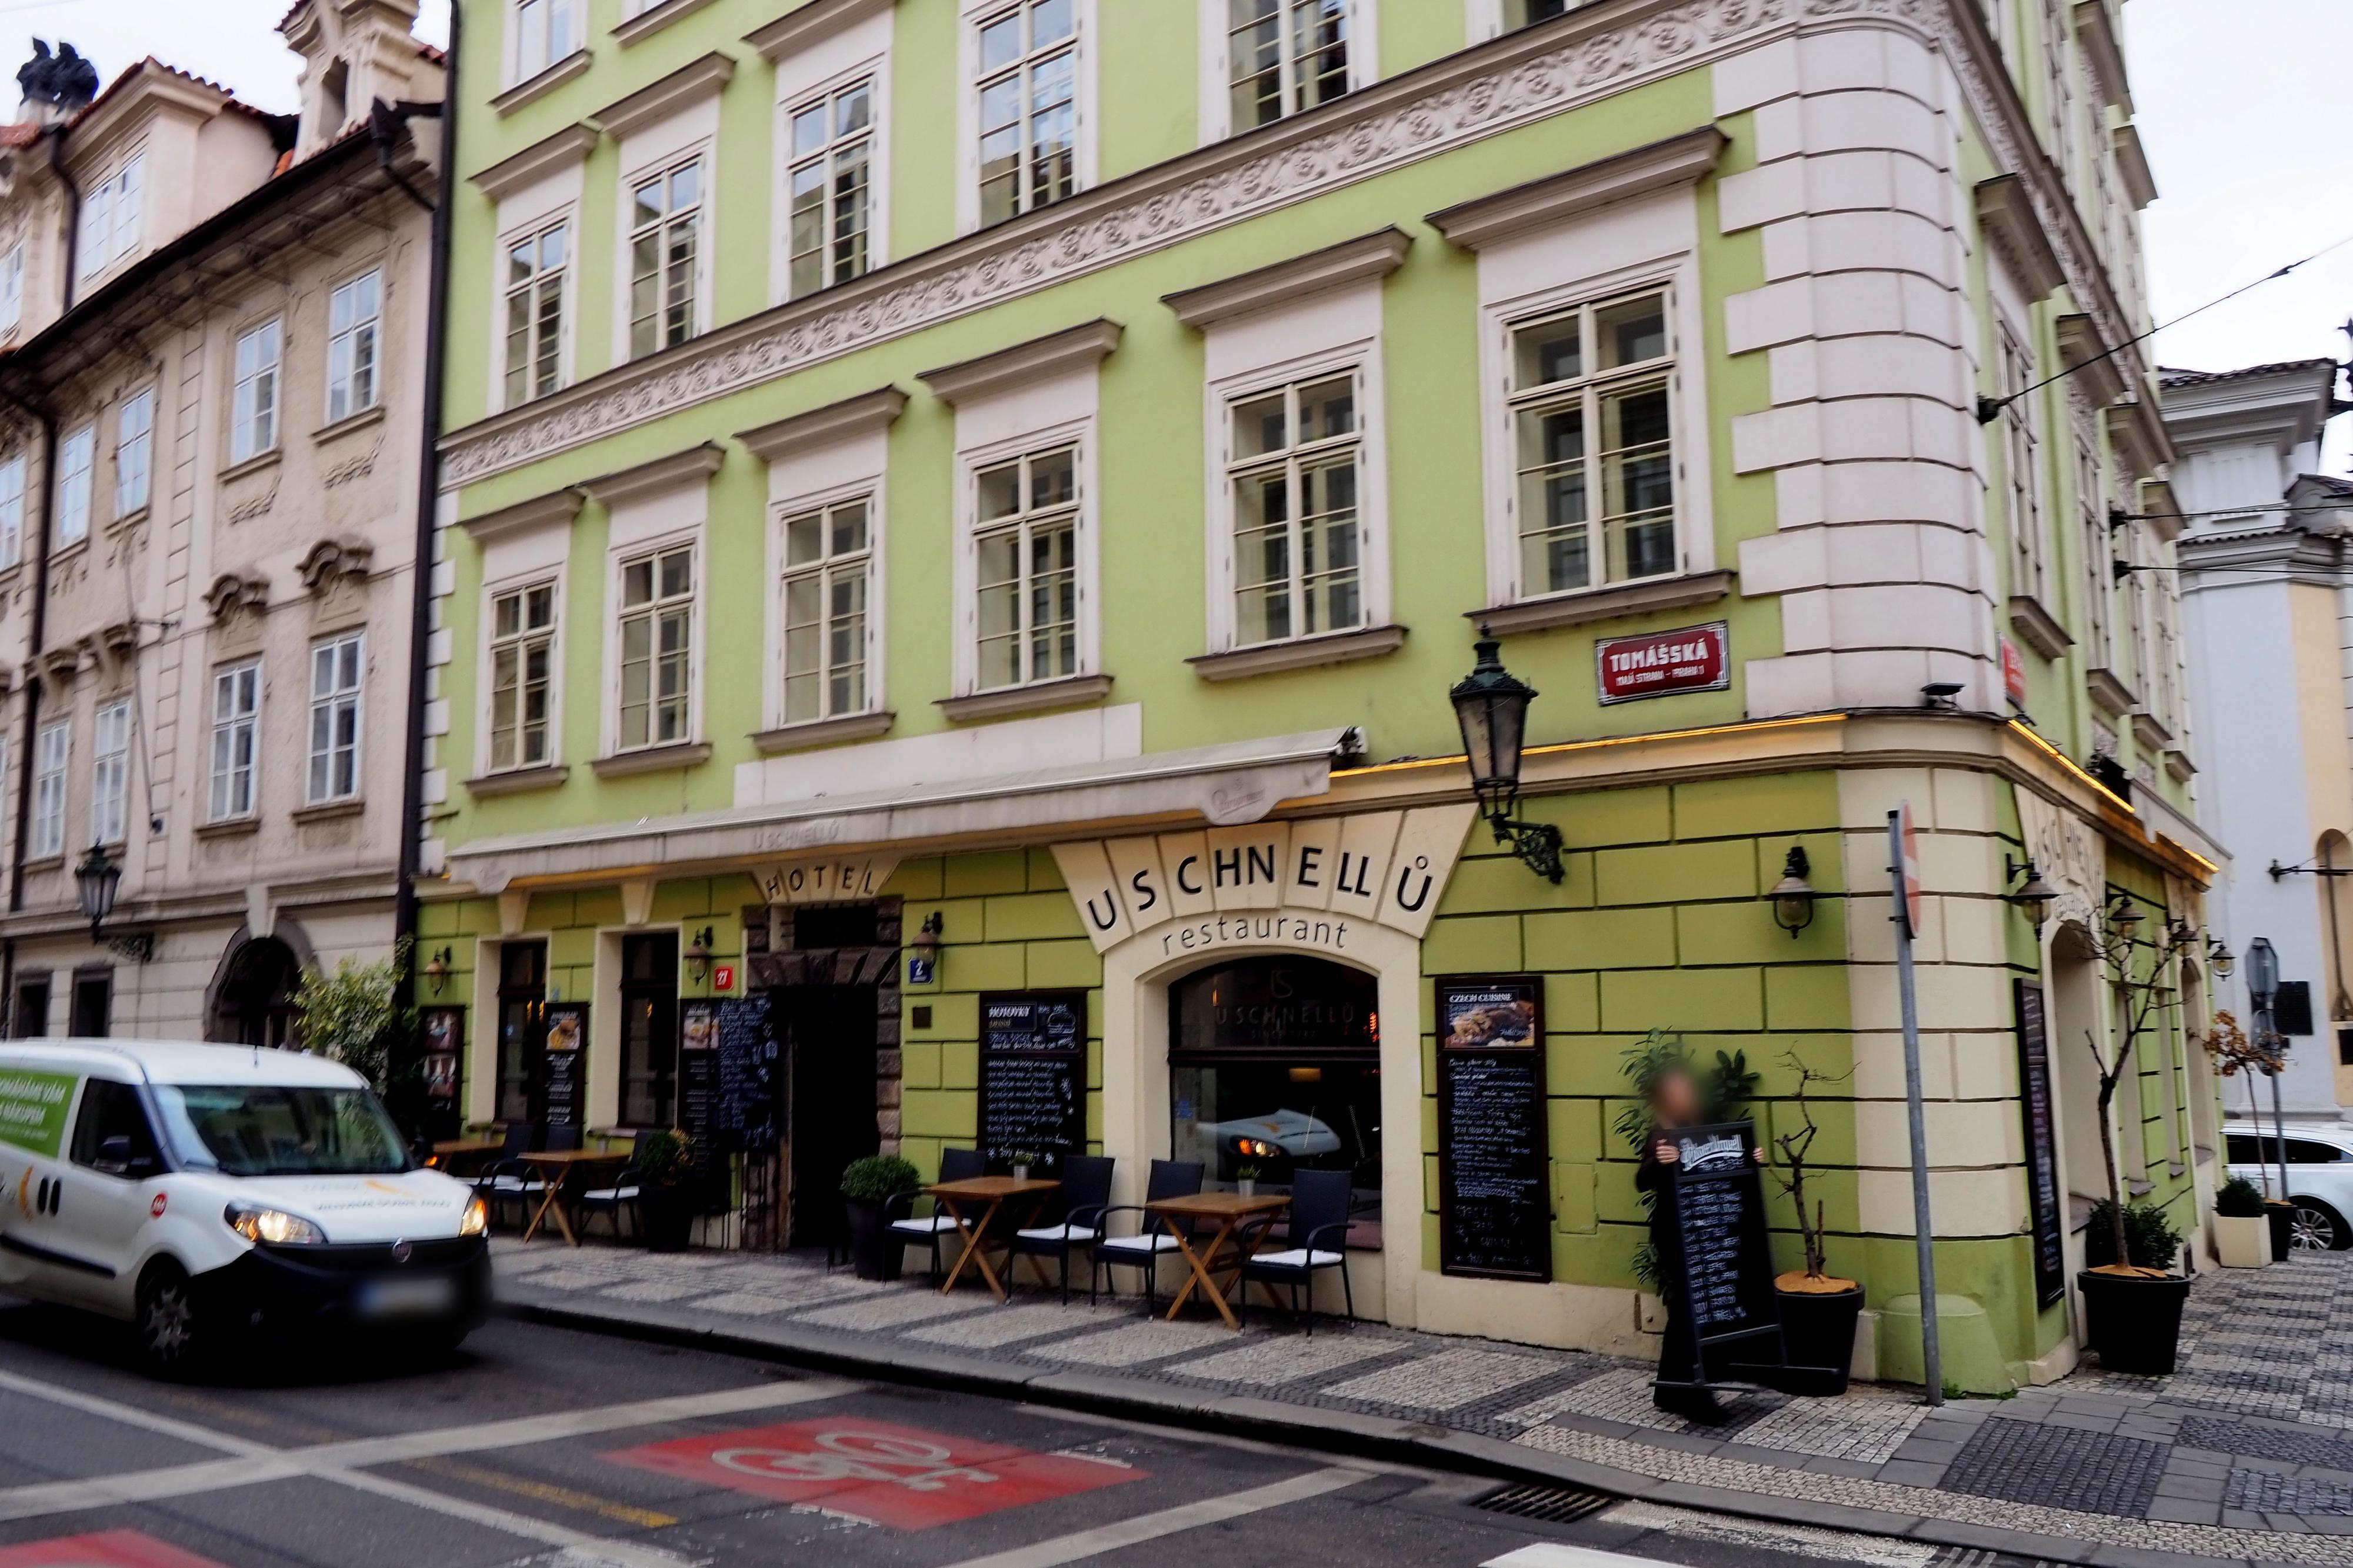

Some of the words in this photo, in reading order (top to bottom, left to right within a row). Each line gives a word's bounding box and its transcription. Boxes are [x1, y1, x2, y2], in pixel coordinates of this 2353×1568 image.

[1609, 638, 1709, 672] TOMÁŠSKÁ
[1616, 672, 1634, 686] MALÁ
[1635, 670, 1665, 683] STRANA
[1672, 666, 1698, 678] PRAHA
[765, 865, 874, 900] HOTEL
[1086, 889, 1116, 931] U
[1132, 845, 1433, 912] SCHNELLŮ
[1162, 915, 1348, 955] restaurant
[989, 1006, 1031, 1017] HOTOVKY
[1449, 993, 1477, 1003] CZECH
[1478, 993, 1513, 1002] CUISINE
